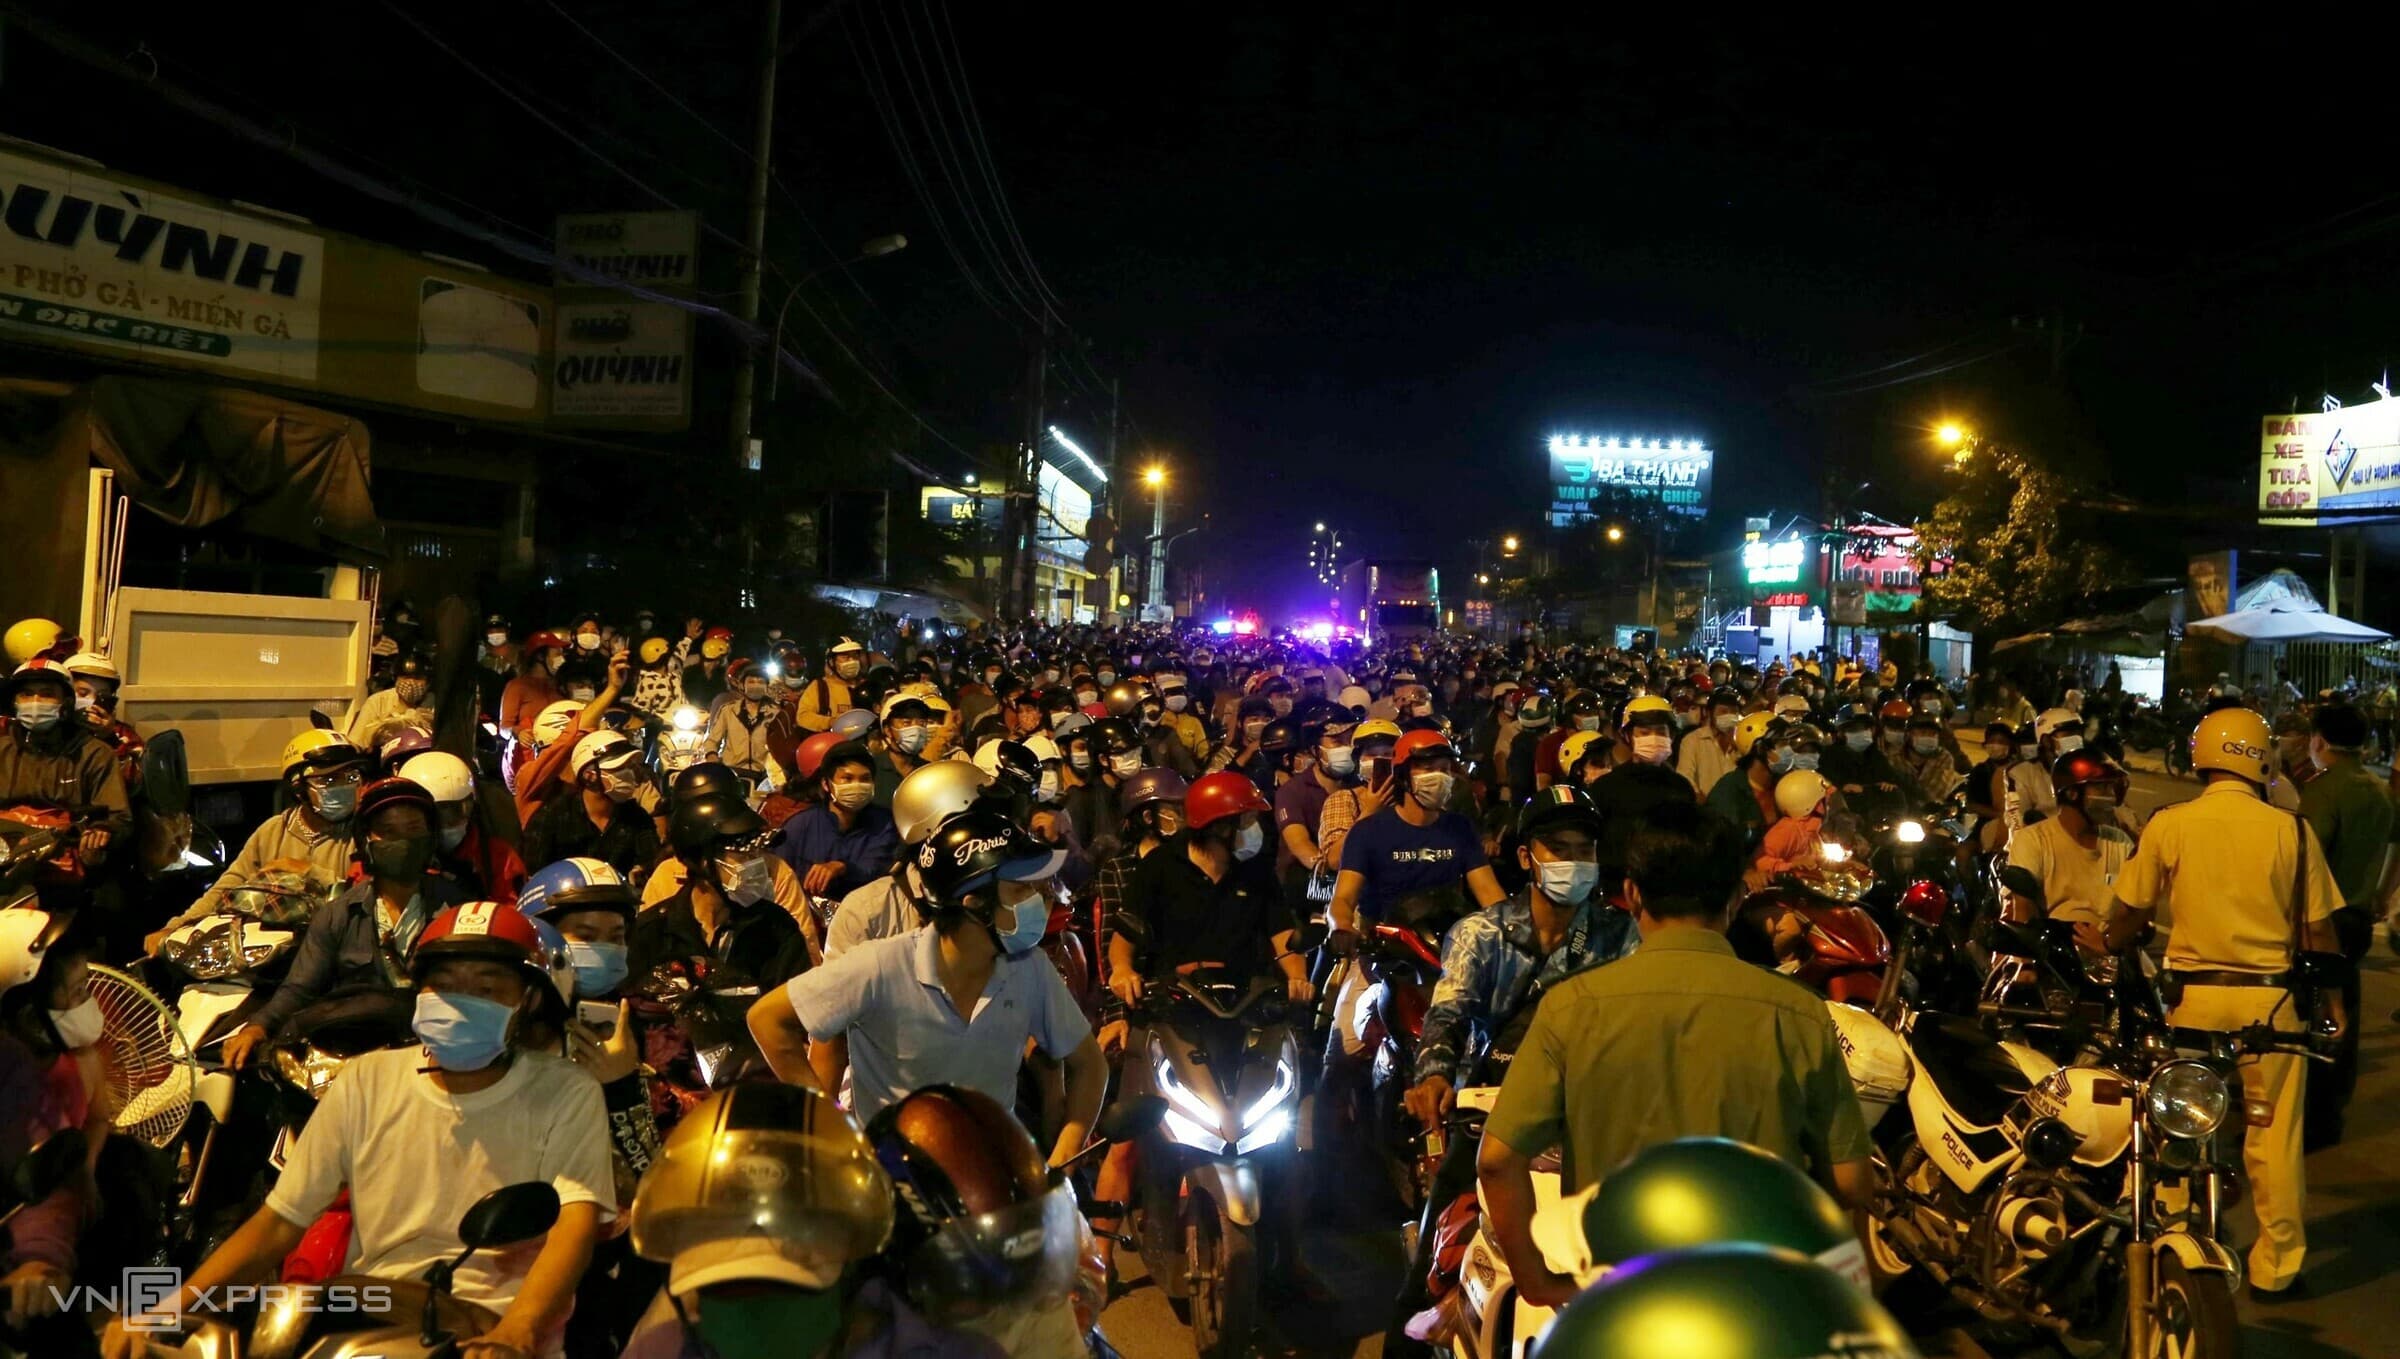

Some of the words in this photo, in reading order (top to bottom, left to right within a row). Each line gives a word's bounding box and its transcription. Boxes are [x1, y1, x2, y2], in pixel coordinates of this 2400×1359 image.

[0, 184, 303, 297] UỲNH
[13, 264, 88, 299] PHỞ
[96, 279, 143, 312] GÀ
[253, 312, 292, 340] GÀ
[556, 346, 683, 390] QUỲNH
[2273, 443, 2304, 459] XE
[2268, 463, 2312, 485] TRẢ
[2266, 487, 2312, 509] GÓP
[953, 835, 1009, 866] Paris
[1942, 1131, 1974, 1171] POLICE
